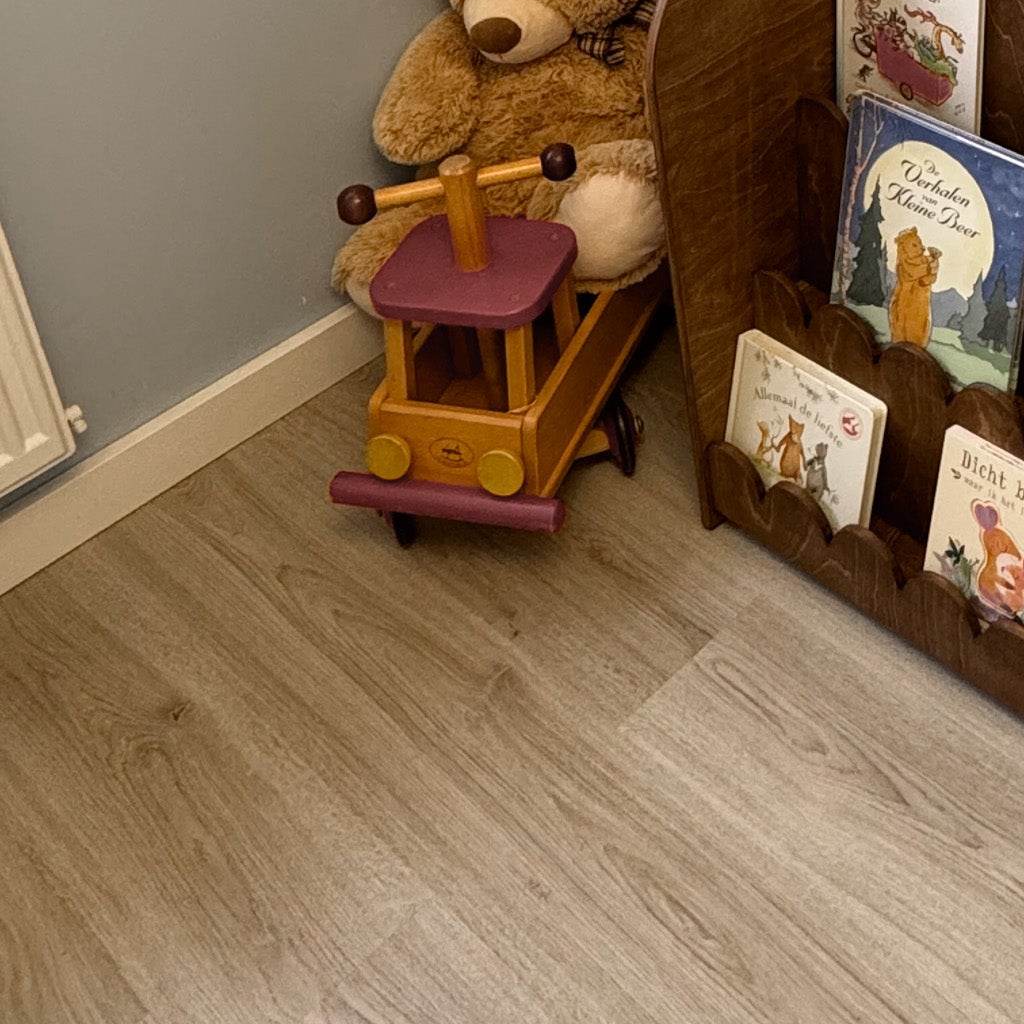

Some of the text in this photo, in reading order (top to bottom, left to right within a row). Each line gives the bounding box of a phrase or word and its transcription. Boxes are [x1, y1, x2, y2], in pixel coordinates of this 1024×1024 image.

[901, 159, 970, 208] Verhalen
[924, 159, 940, 176] De
[886, 182, 981, 238] Kleine Beer
[922, 195, 938, 206] van
[754, 387, 843, 448] Allemaal de liefste
[961, 449, 1007, 489] Dicht
